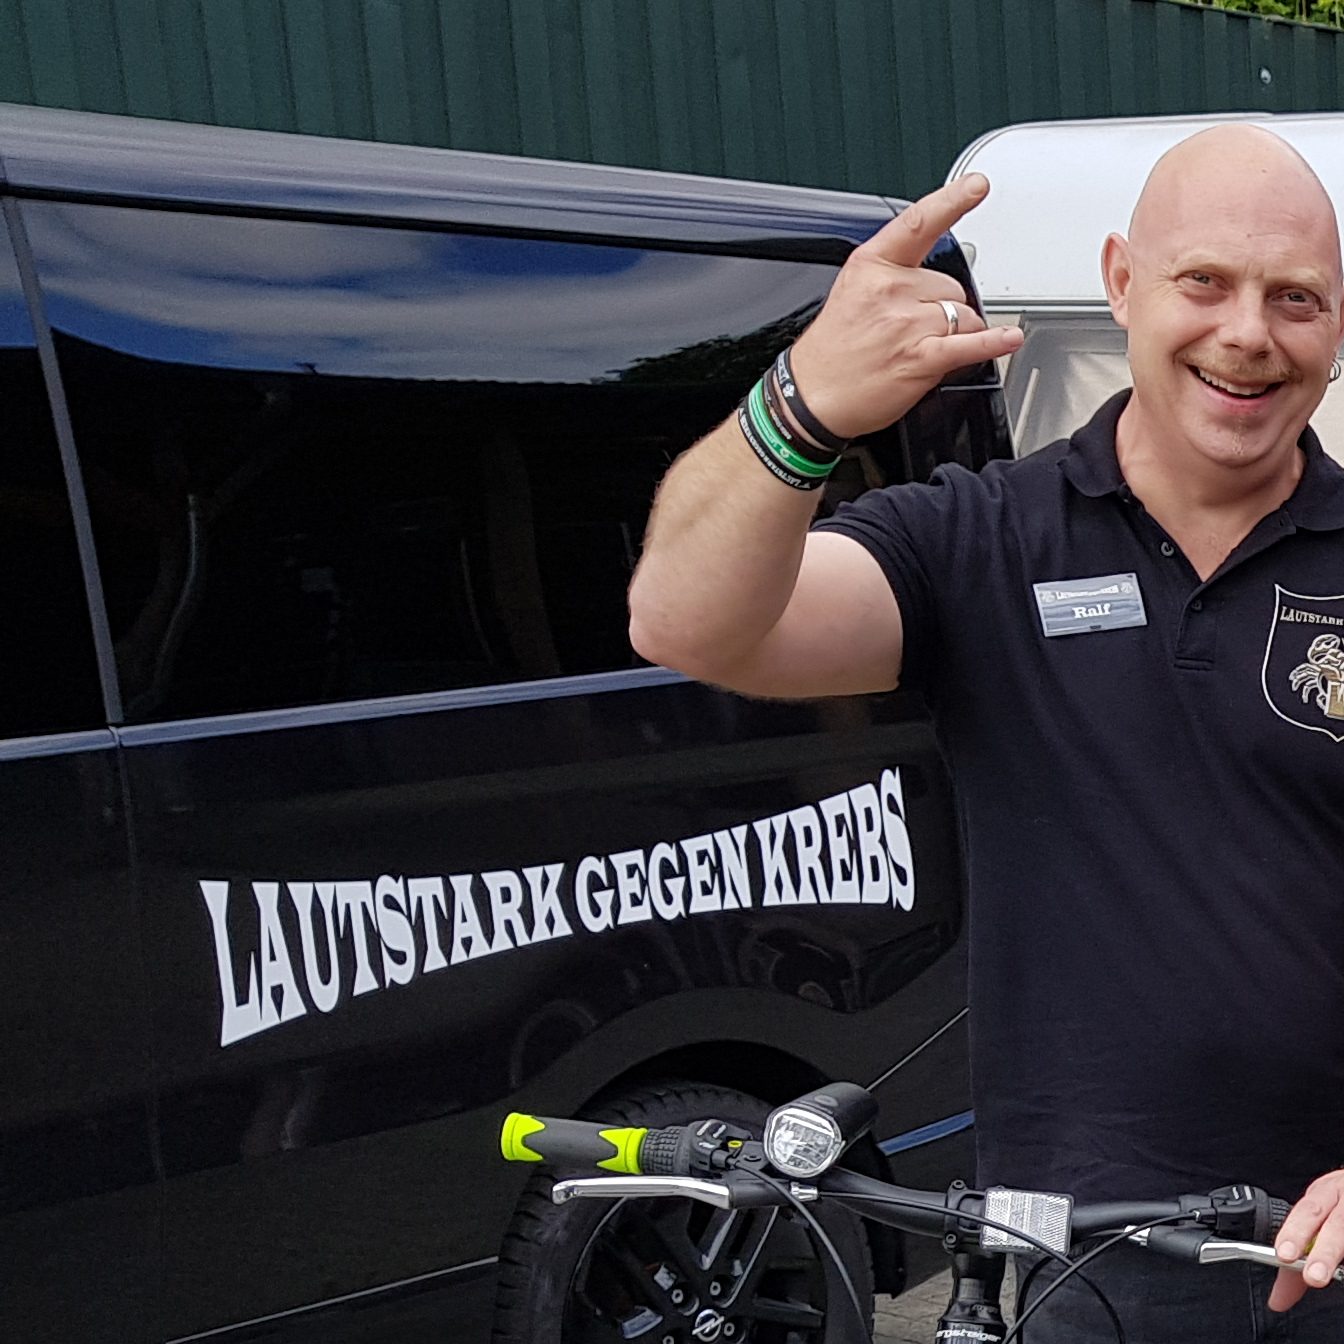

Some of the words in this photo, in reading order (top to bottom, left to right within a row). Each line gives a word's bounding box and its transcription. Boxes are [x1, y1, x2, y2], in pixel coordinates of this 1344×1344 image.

[1072, 603, 1111, 619] Ralf
[1280, 606, 1344, 626] LAUTSTARK
[199, 861, 574, 1047] LAUTSTARK
[574, 826, 753, 933] GEGEN
[756, 766, 916, 912] KREBS
